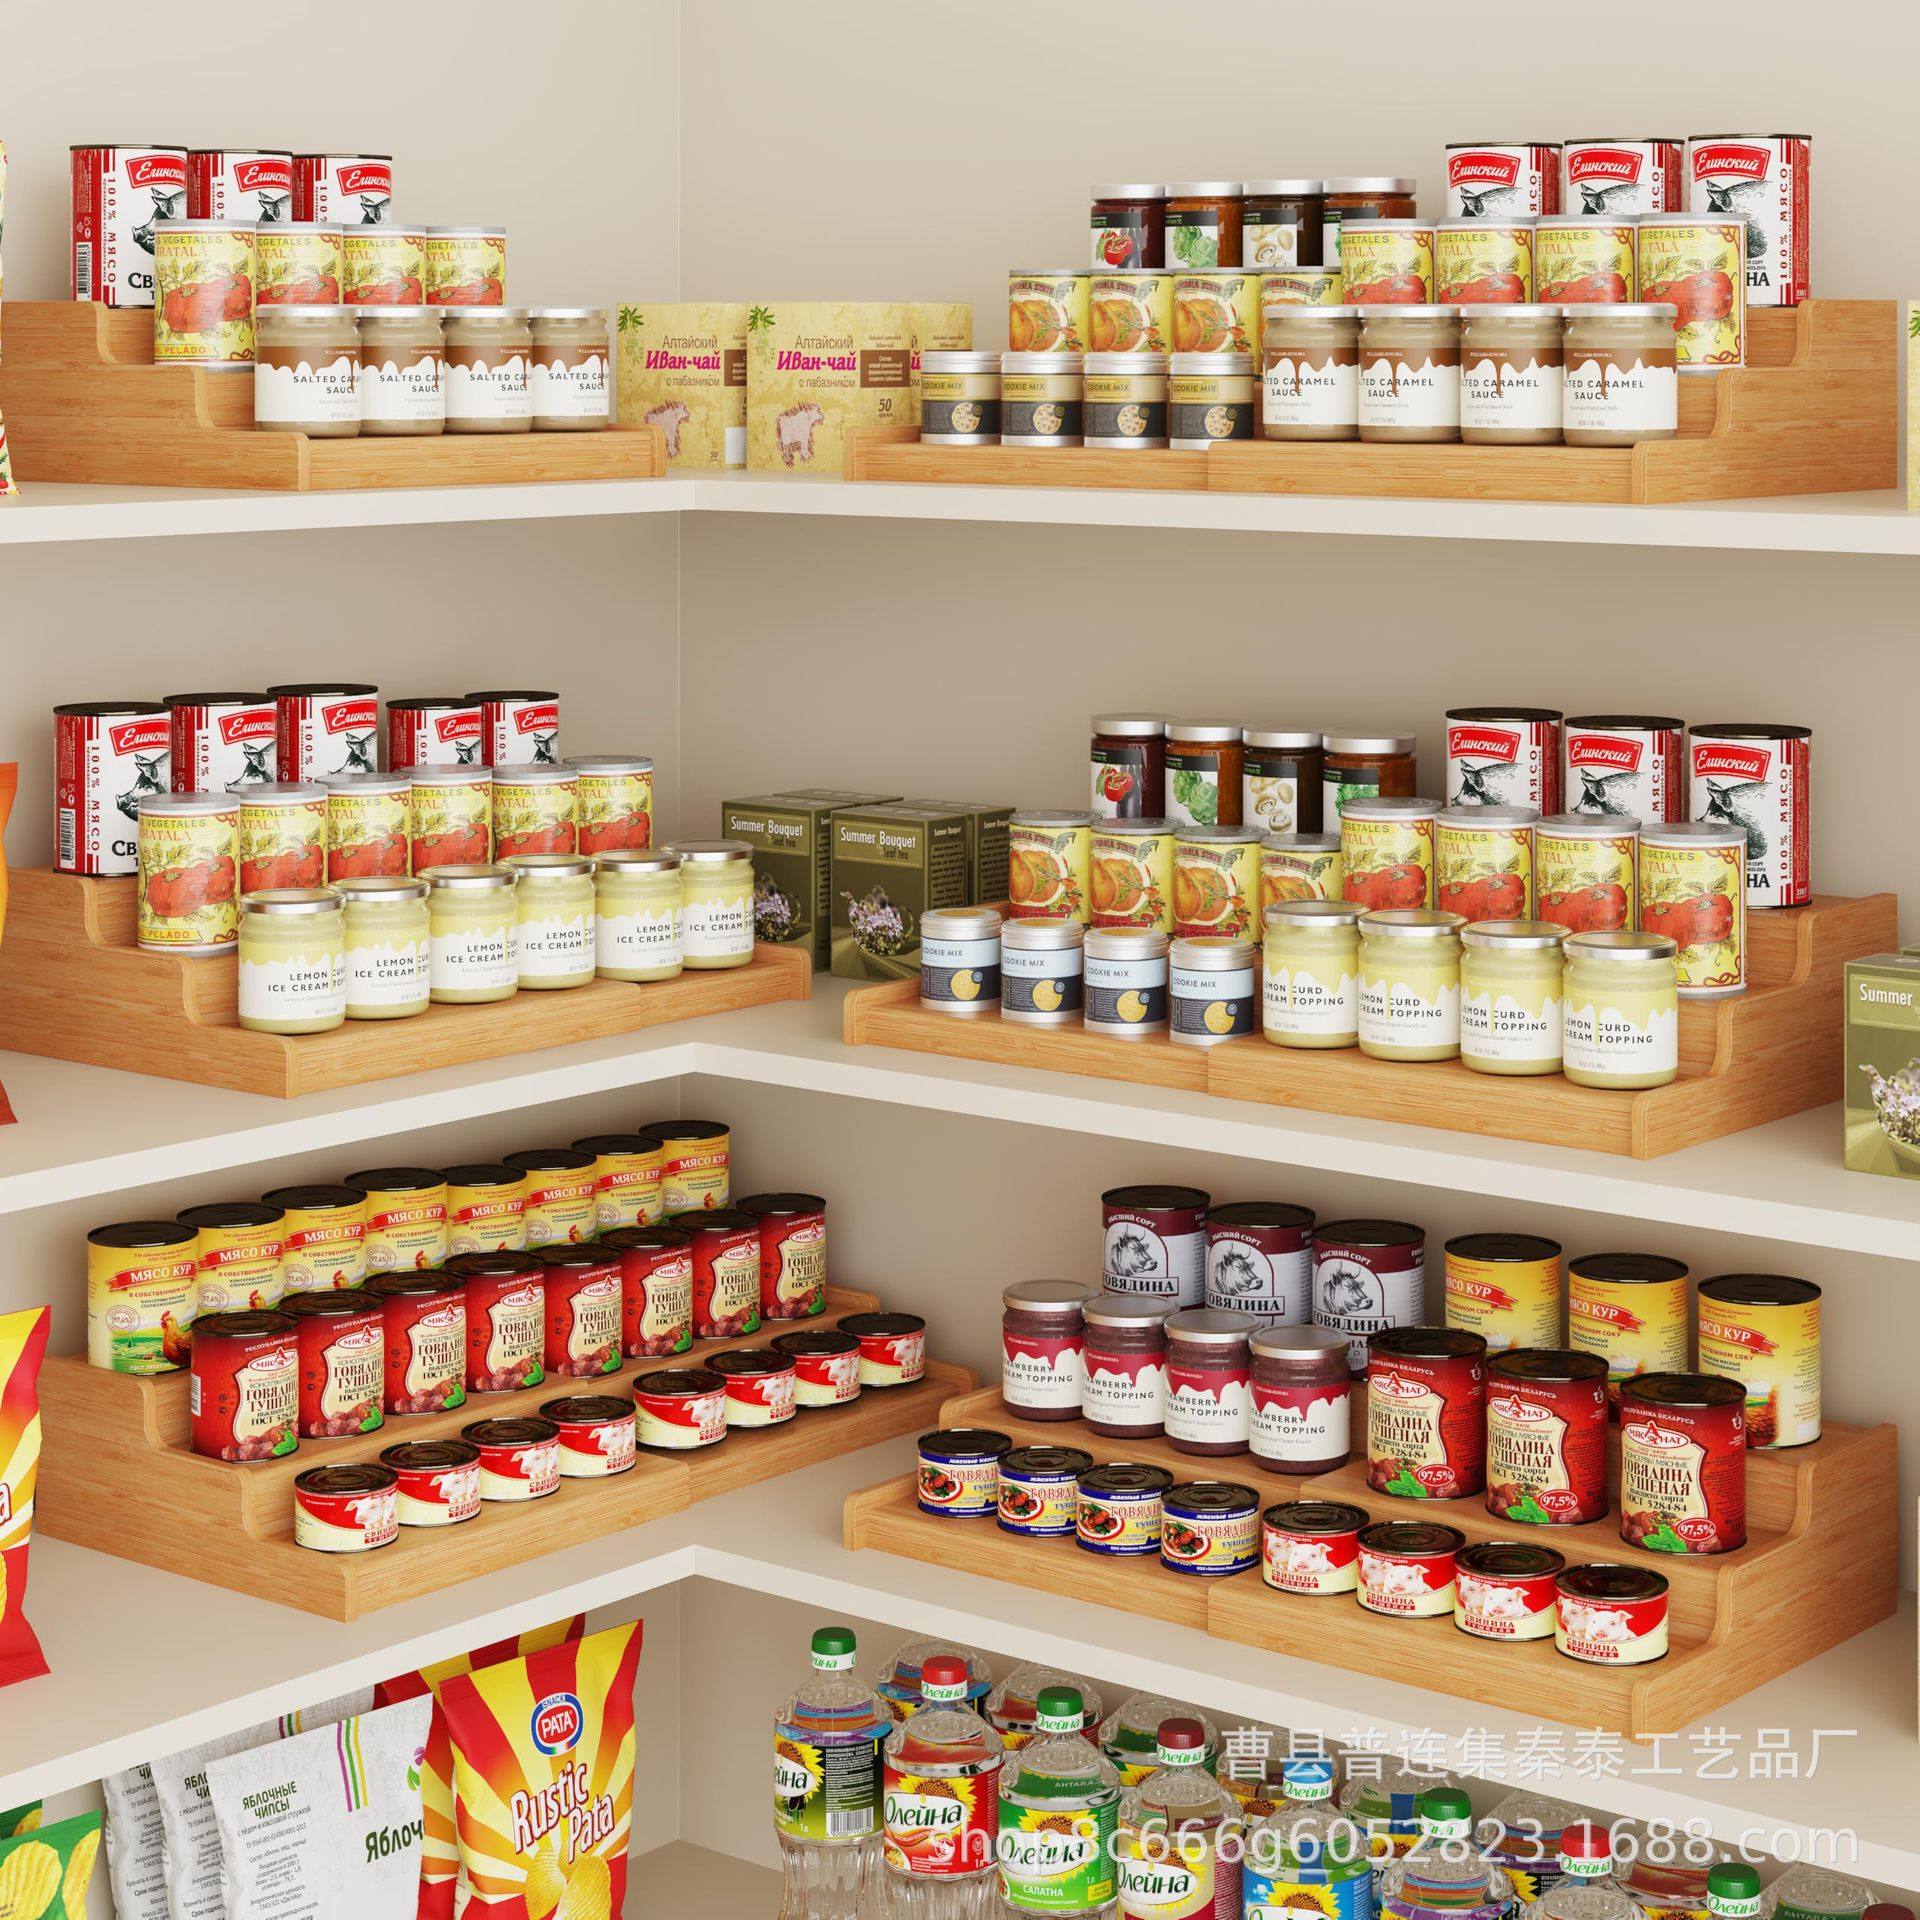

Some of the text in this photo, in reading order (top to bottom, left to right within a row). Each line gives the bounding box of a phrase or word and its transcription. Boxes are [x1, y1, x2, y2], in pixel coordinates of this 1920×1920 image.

[1451, 159, 1509, 179] Елинский
[1571, 156, 1631, 176] Елинский
[1696, 152, 1760, 173] Елинский
[1780, 168, 1789, 281] 100% МЯСО
[107, 231, 117, 283] МЯСО
[662, 335, 718, 350] Алтайский
[795, 335, 854, 350] Алтайский
[645, 350, 721, 370] Иван-чай
[776, 350, 857, 371] Иван-чай
[293, 375, 337, 383] SALTED
[379, 374, 422, 382] SALTED
[470, 373, 511, 381] SALTED
[674, 374, 720, 388] лабазником
[806, 374, 856, 389] лабазником
[1282, 377, 1336, 386] CARAMEL
[1379, 378, 1434, 387] CARAMEL
[1483, 379, 1539, 388] CARAMEL
[922, 382, 945, 390] COOKIE
[1004, 383, 1027, 391] COOKIE
[1087, 384, 1129, 392] COOKIE MIX
[1173, 384, 1217, 392] COOKIE MIX
[1587, 380, 1644, 389] CARAMEL
[878, 398, 892, 412] 50
[1451, 732, 1509, 754] Елинский
[1571, 741, 1632, 763] Елинский
[1696, 749, 1760, 773] Елинский
[1529, 750, 1538, 802] МЯСО
[1652, 758, 1660, 812] МЯСО
[1780, 768, 1789, 823] МЯСО
[91, 800, 100, 851] МЯСО
[147, 818, 207, 829] VEGETALES
[731, 815, 804, 838] Summer Bouquet
[786, 838, 797, 848] tea
[840, 827, 917, 849] Summer Bouquet
[898, 849, 909, 860] tea
[709, 912, 742, 922] LEMON
[636, 924, 670, 934] LEMON
[689, 922, 743, 932] ICE CREAM
[546, 930, 581, 940] LEMON
[616, 934, 671, 944] ICE CREAM
[467, 943, 503, 952] LEMON
[526, 940, 582, 950] ICE CREAM
[923, 947, 945, 956] COOKIE
[376, 957, 414, 967] LEMON
[446, 953, 504, 963] ICE CREAM
[1004, 957, 1027, 966] COOKIE
[290, 971, 328, 981] LEMON
[355, 967, 415, 978] ICE CREAM
[268, 981, 329, 992] ICE CREAM
[1292, 996, 1344, 1005] TOPPING
[1859, 983, 1913, 1007] Summer
[1390, 1009, 1442, 1018] TOPPING
[1493, 1022, 1547, 1031] TOPPING
[1598, 1034, 1653, 1044] TOPPING
[645, 1169, 661, 1180] КУР
[578, 1184, 593, 1196] КУР
[507, 1199, 523, 1211] КУР
[426, 1206, 443, 1218] КУР
[1135, 1217, 1157, 1229] СОРТ
[343, 1225, 362, 1238] КУР
[1240, 1235, 1263, 1247] СОРТ
[219, 1244, 279, 1263] МЯСО КУР
[1350, 1253, 1372, 1265] СОРТ
[130, 1264, 192, 1284] МЯСО КУР
[1400, 1363, 1435, 1377] БЕЛАРУСЬ
[1026, 1374, 1073, 1383] TOPPING
[1107, 1391, 1154, 1400] TOPPING
[1520, 1387, 1557, 1400] БЕЛАРУСЬ
[1190, 1407, 1239, 1417] TOPPING
[1657, 1412, 1695, 1426] БЕЛАРУСЬ
[1418, 1470, 1454, 1482] 97,5%
[1542, 1494, 1577, 1508] 97,5%
[1680, 1523, 1715, 1536] 97,5%
[1271, 1568, 1319, 1584] СВИНИНА
[1366, 1591, 1416, 1605] СВИНИНА
[1464, 1613, 1515, 1628] СВИНИНА
[1566, 1636, 1619, 1652] СВИНИНА
[921, 1682, 965, 1699] Олейна
[542, 1693, 566, 1710] SNACK
[540, 1710, 575, 1740] PATA
[1036, 1714, 1081, 1731] Олейна
[1157, 1747, 1203, 1765] Олейна
[242, 1781, 298, 1811] ЯБЛОЧНЫЕ
[1283, 1782, 1329, 1799] Олейна
[254, 1797, 291, 1820] ЧИПСЫ
[510, 1760, 589, 1855] Rustic
[883, 1796, 962, 1825] Олейна
[568, 1794, 615, 1865] Pata
[1001, 1833, 1084, 1865] Олейна
[1117, 1862, 1191, 1895] Олейна
[1023, 1884, 1064, 1897] САЛАТНА
